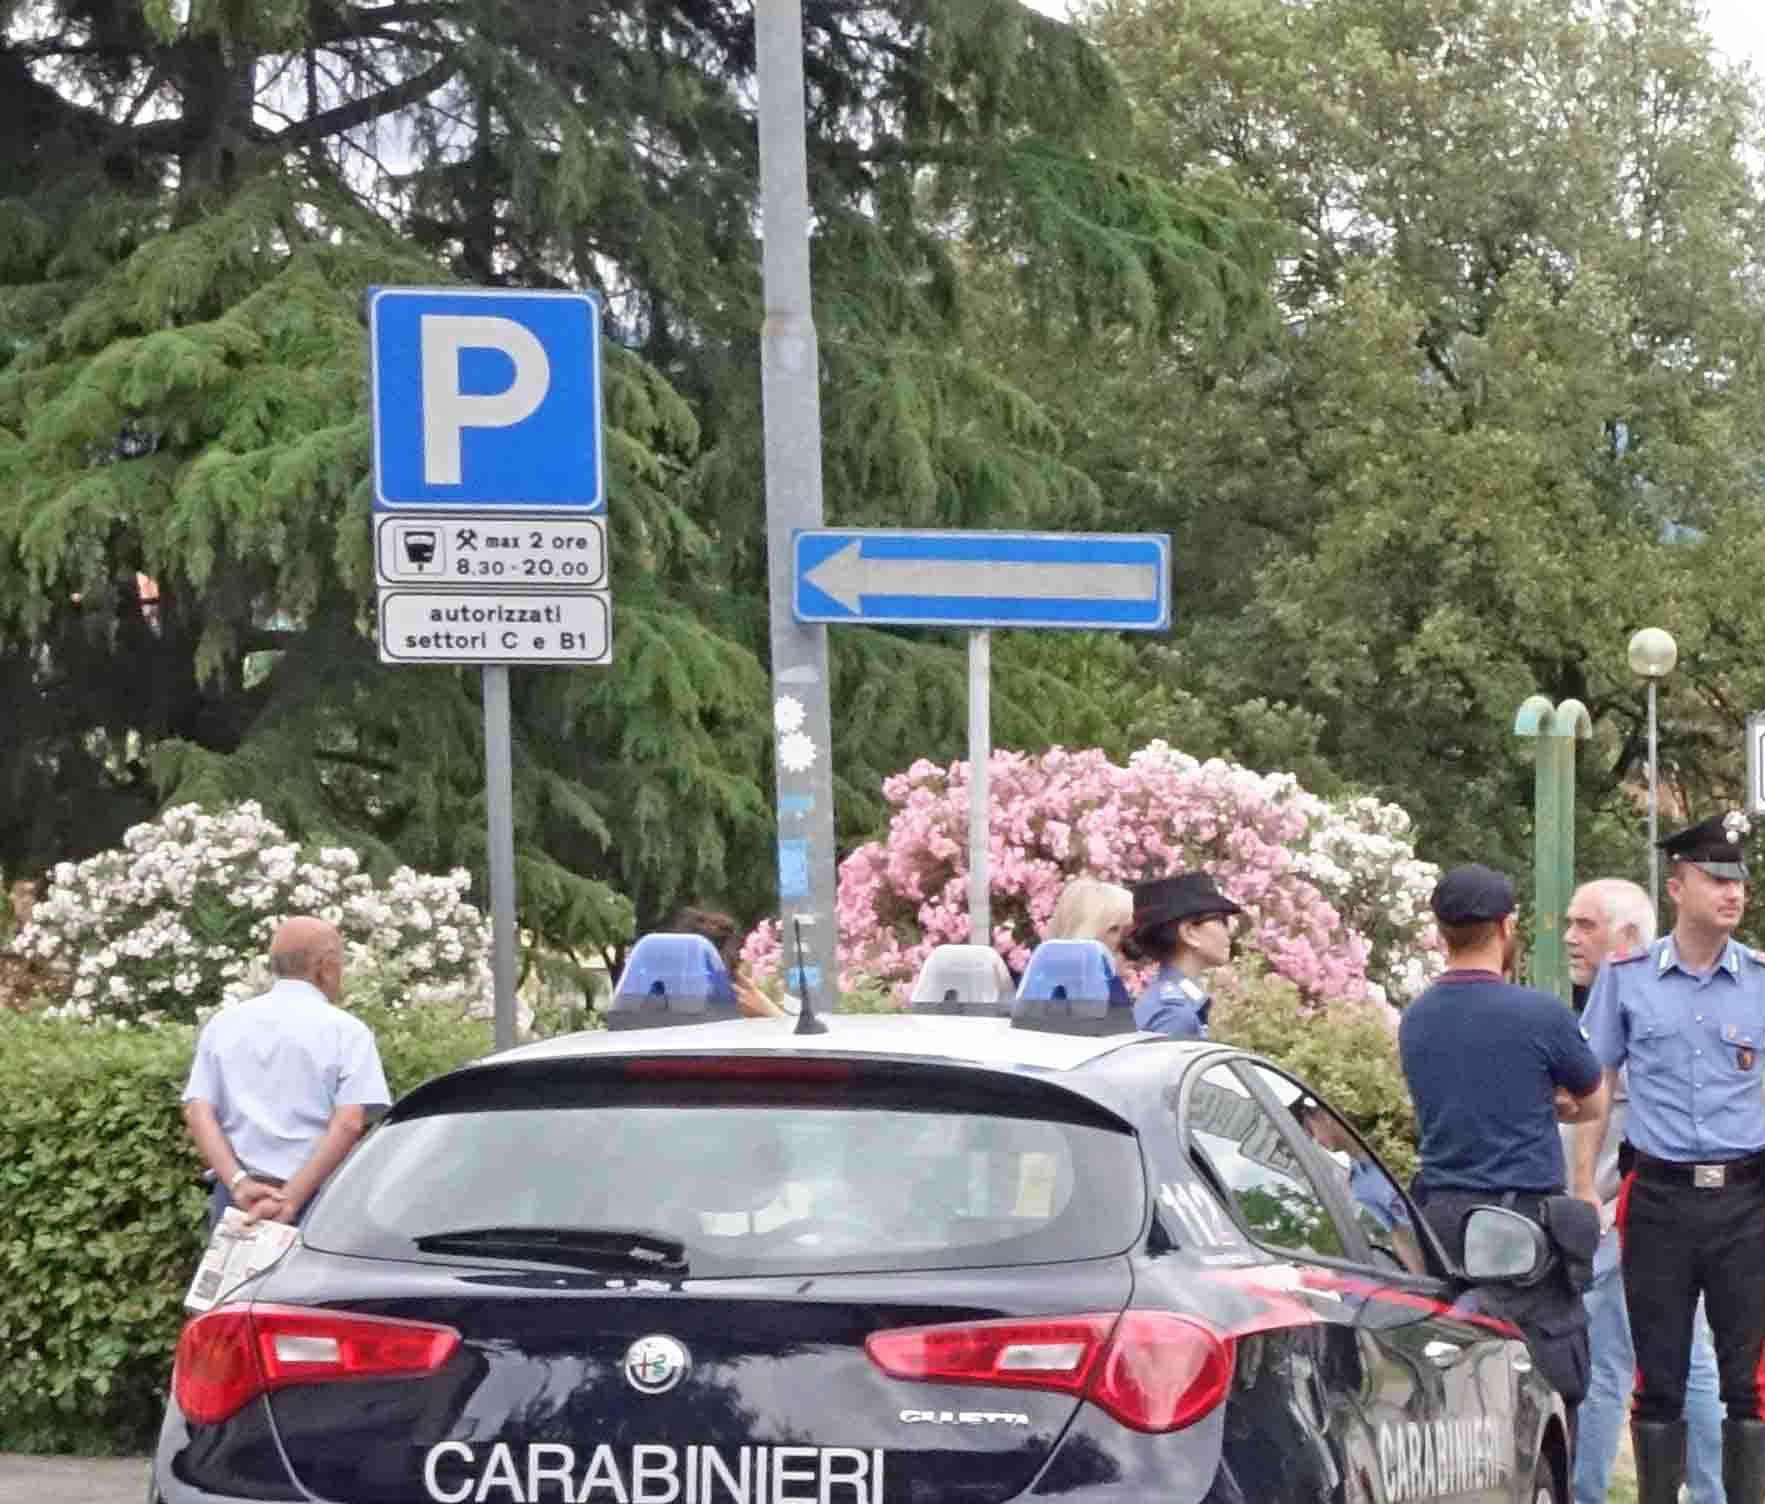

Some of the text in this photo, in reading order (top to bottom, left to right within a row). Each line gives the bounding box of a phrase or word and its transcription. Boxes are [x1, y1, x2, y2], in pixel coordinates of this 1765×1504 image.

[421, 314, 550, 485] P
[485, 531, 588, 549] max 2 ore
[456, 558, 505, 576] 8.30
[523, 559, 589, 576] 20.00
[429, 604, 562, 623] autorizzati
[404, 631, 587, 650] settori C e B1
